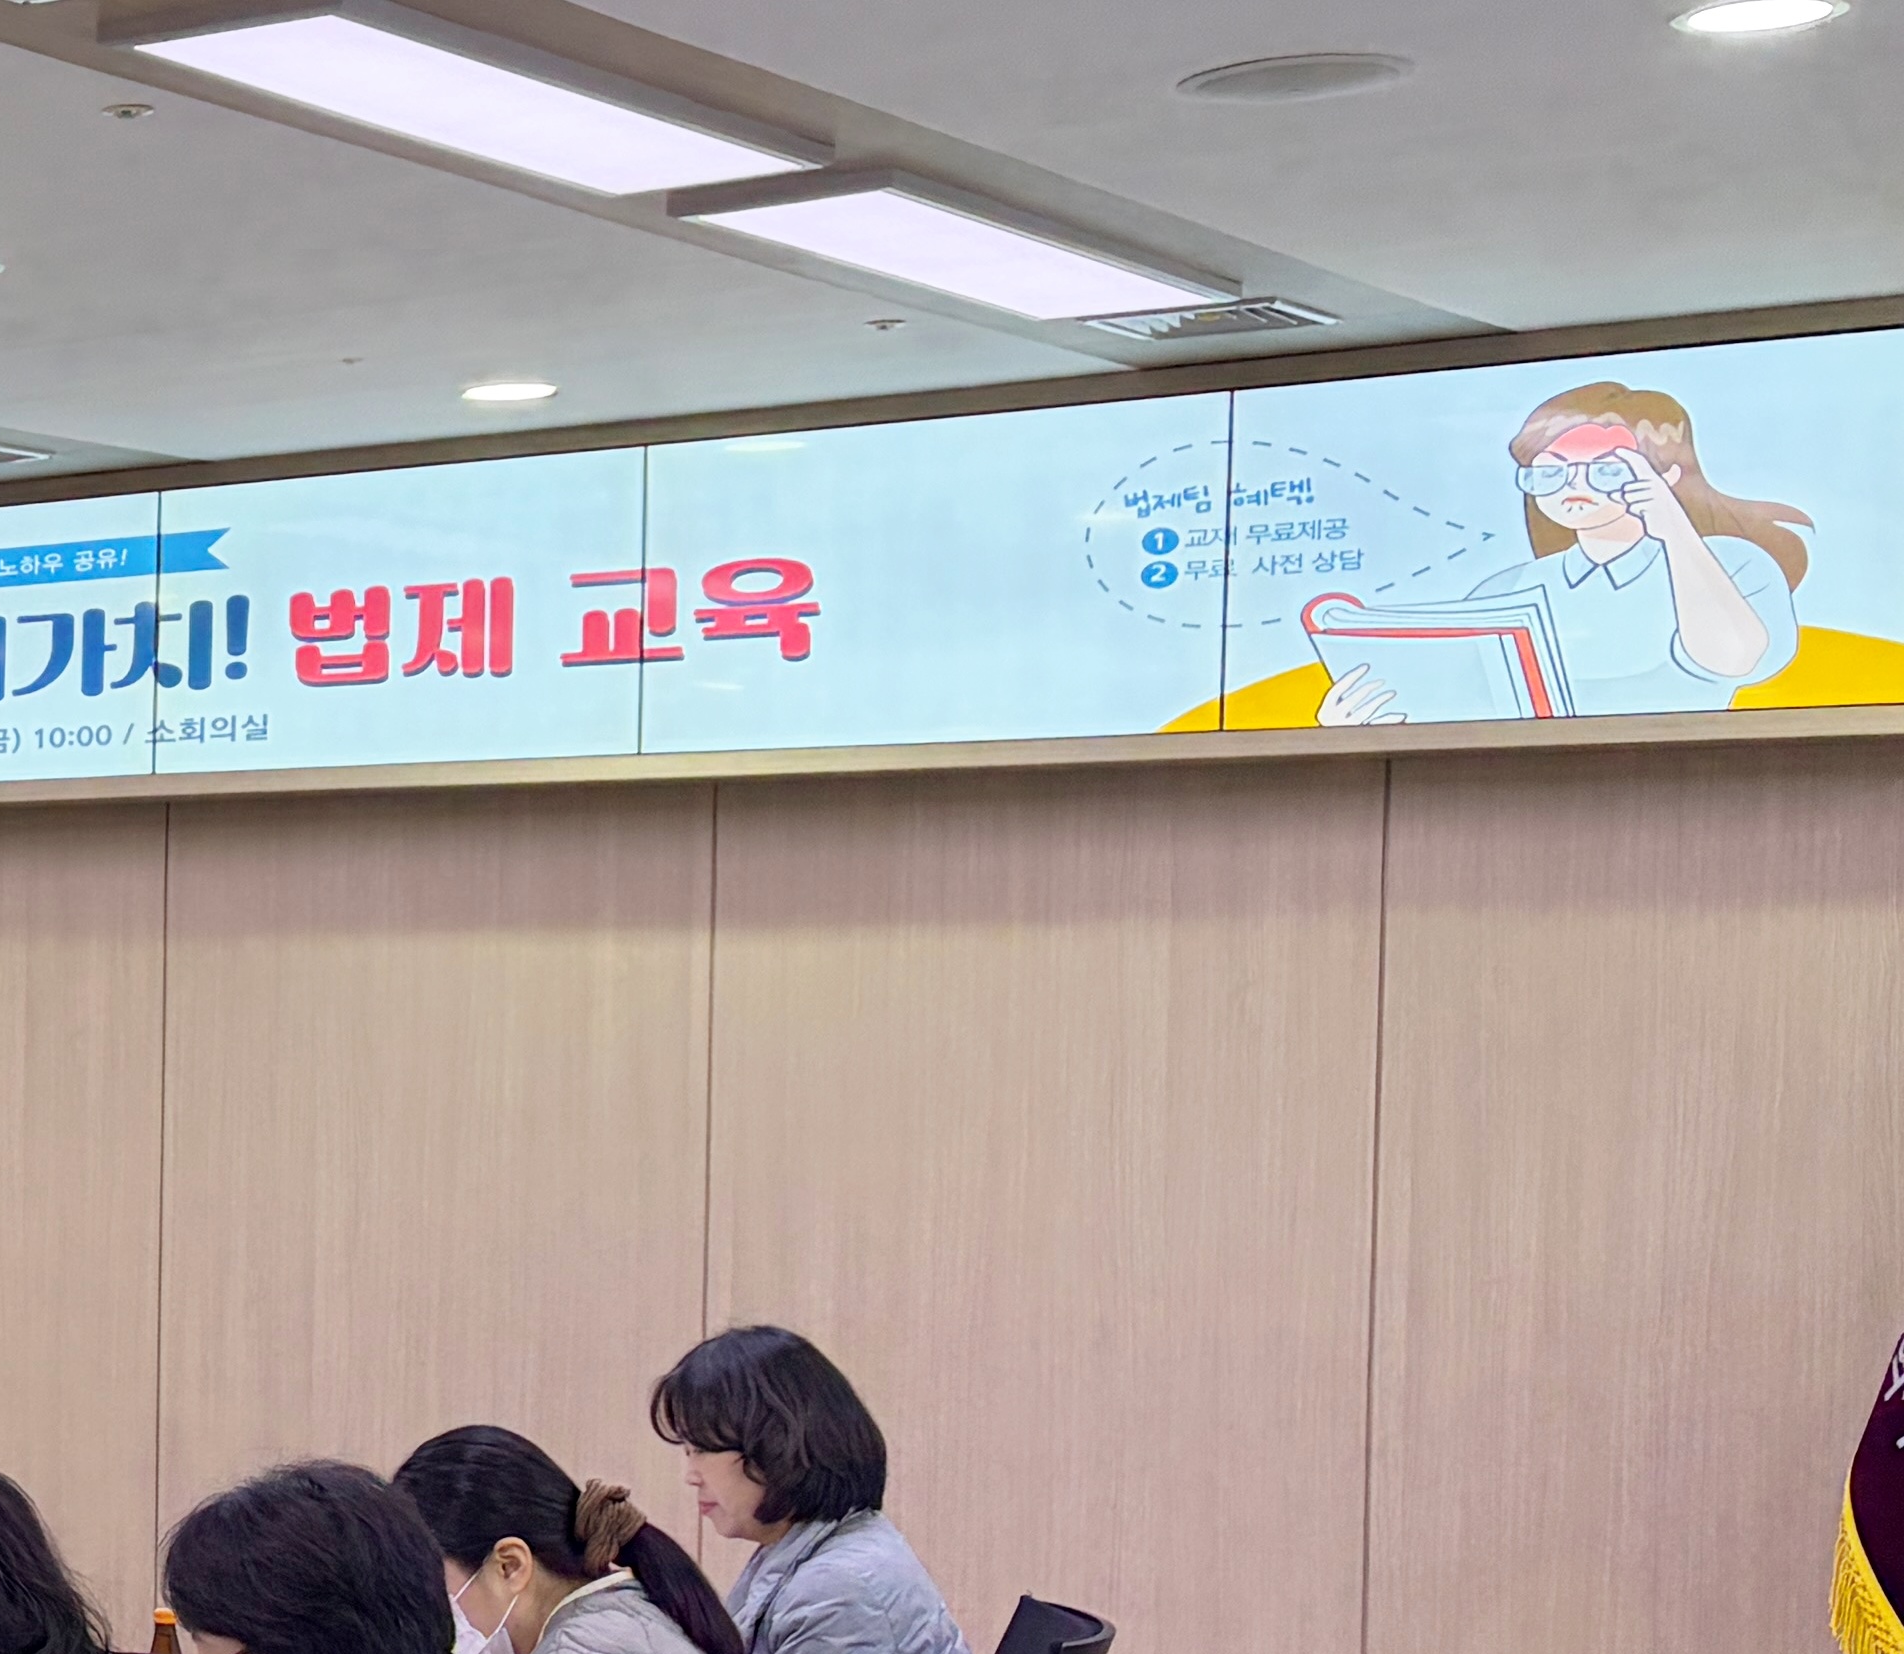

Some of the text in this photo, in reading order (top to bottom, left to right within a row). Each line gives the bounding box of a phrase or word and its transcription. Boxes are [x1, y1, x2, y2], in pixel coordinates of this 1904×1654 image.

[1124, 477, 1314, 519] 법제팀 혜택!
[1183, 526, 1238, 549] 교재
[1245, 518, 1349, 545] 무료제공
[73, 548, 129, 573] 공유!
[1183, 559, 1237, 580] 무료
[1252, 553, 1304, 577] 사전
[1312, 547, 1365, 573] 상담
[290, 576, 514, 687] 법제
[561, 557, 821, 667] 교육
[35, 723, 112, 750] 10:00
[123, 723, 135, 744] /
[146, 713, 269, 746] 소회의실
